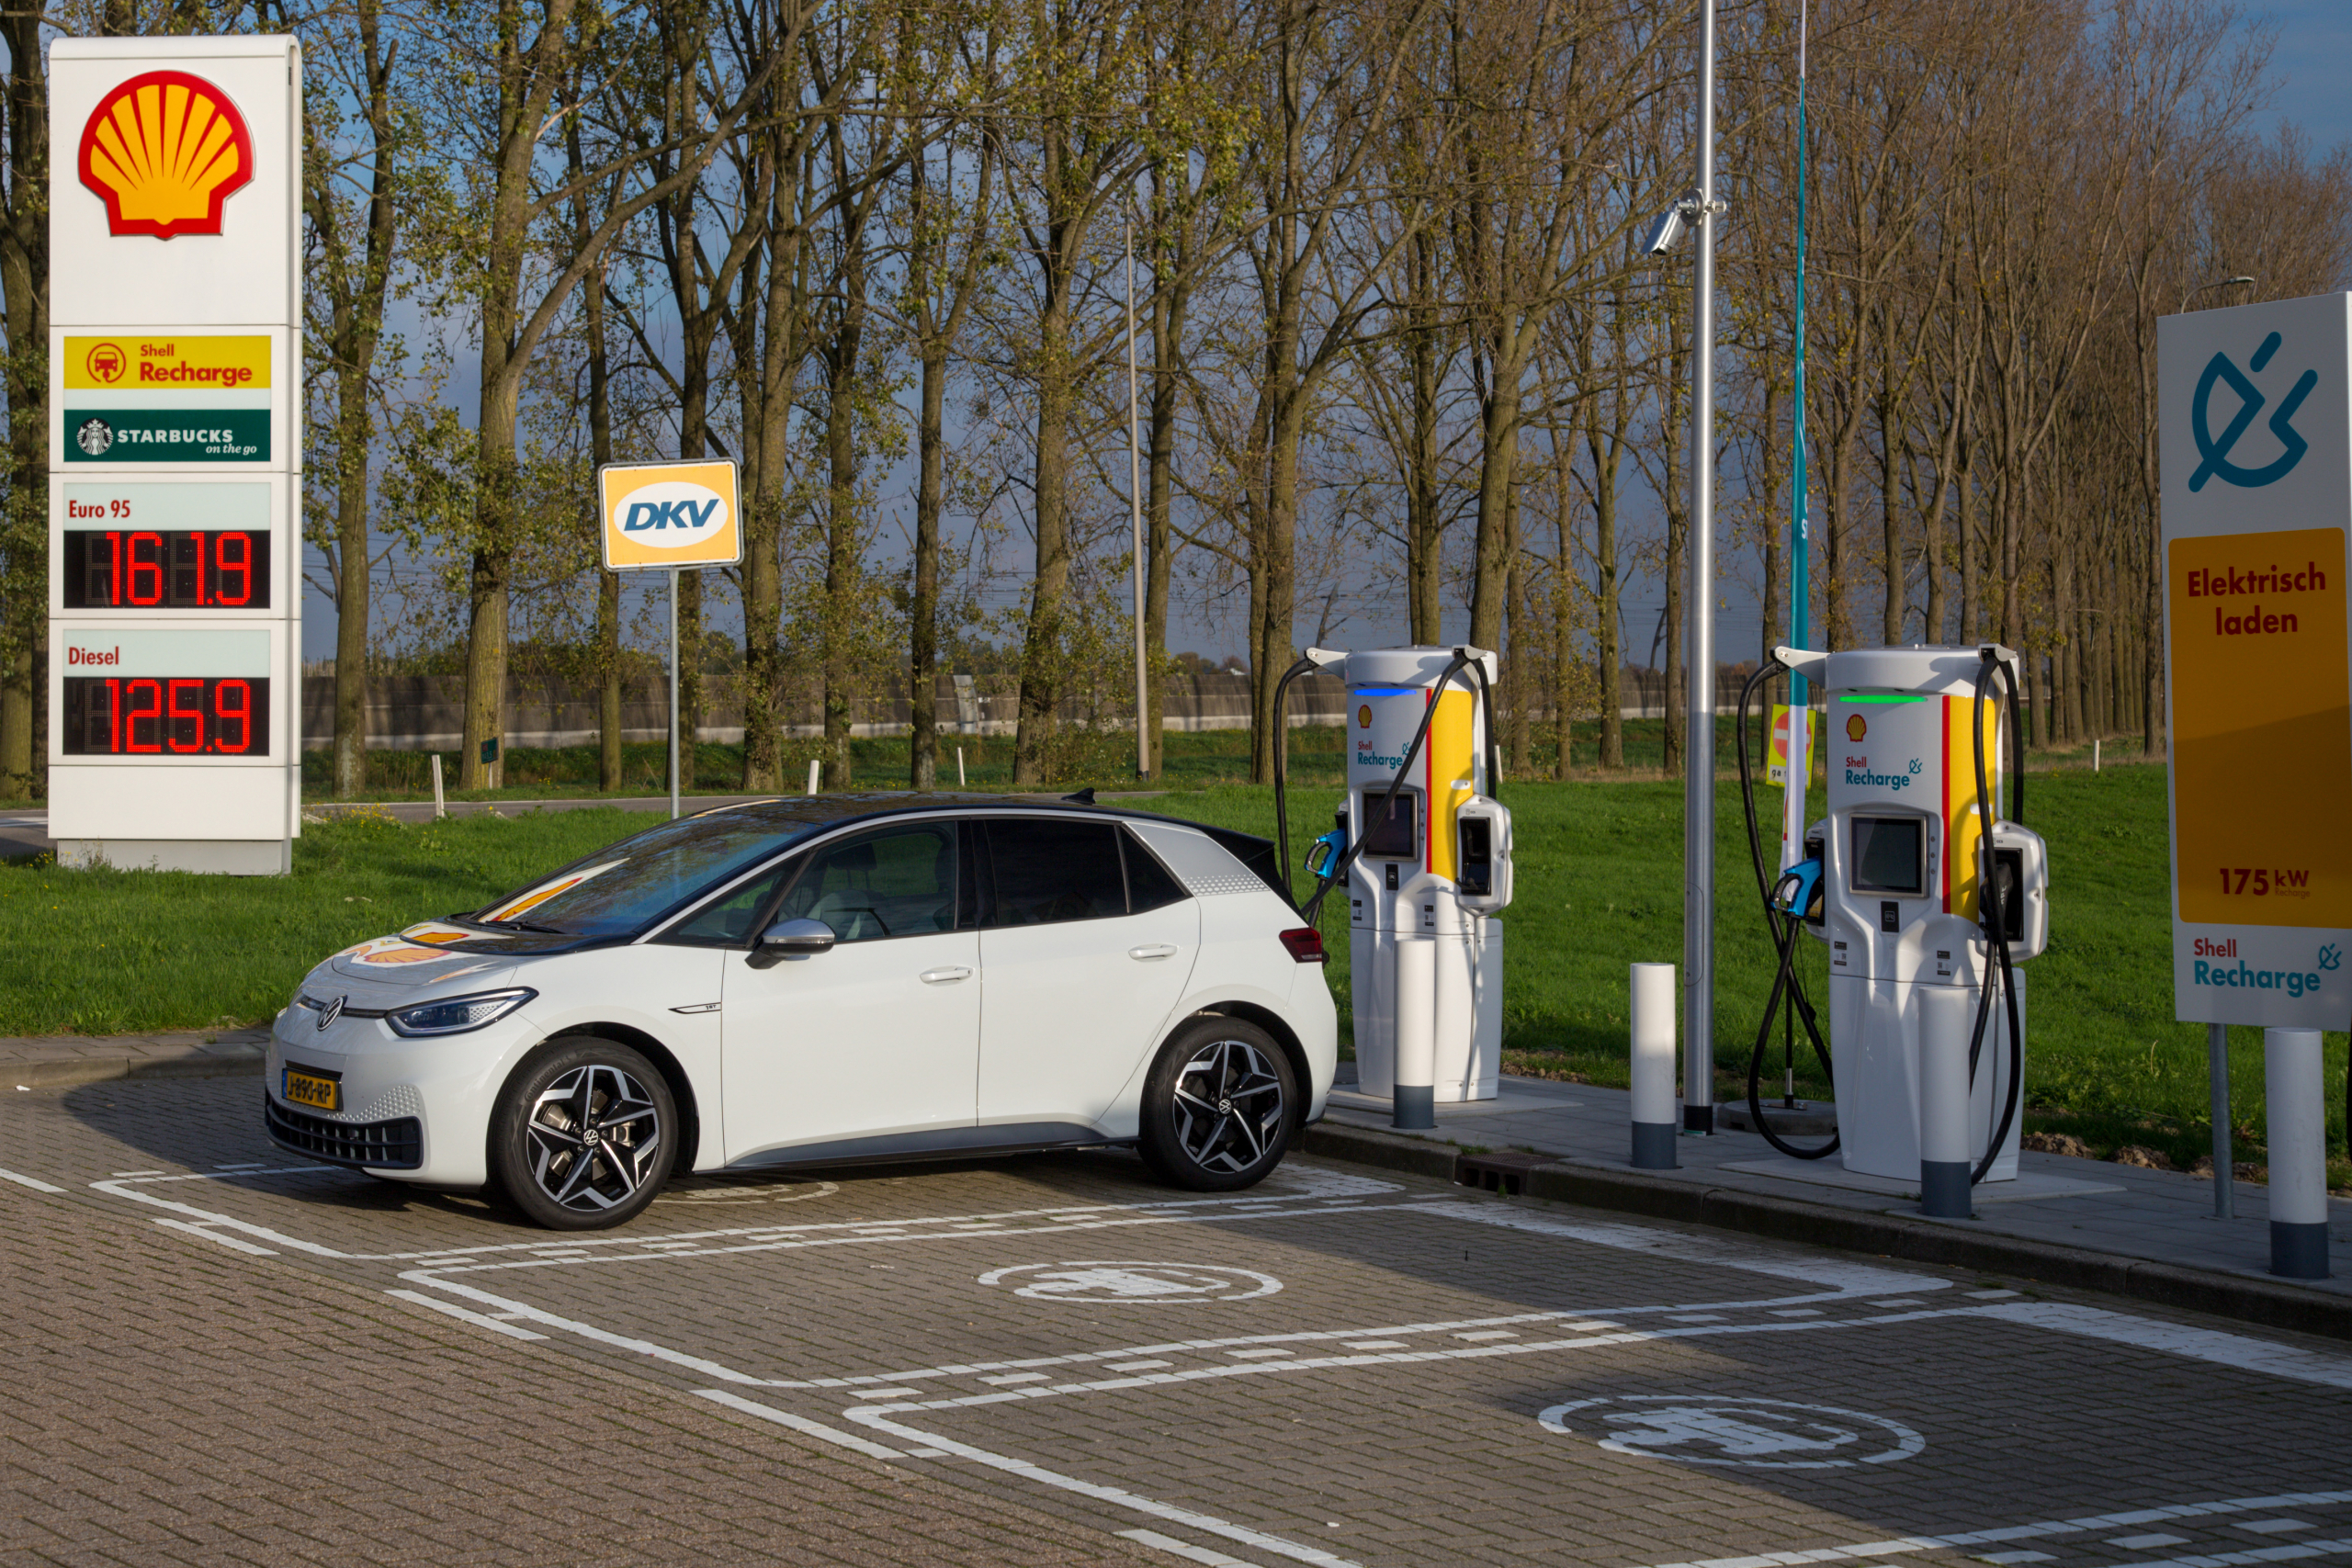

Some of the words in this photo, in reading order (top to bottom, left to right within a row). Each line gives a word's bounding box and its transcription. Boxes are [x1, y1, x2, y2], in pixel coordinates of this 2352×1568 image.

[141, 344, 175, 356] Shell
[140, 361, 253, 387] Recharge
[118, 429, 233, 443] STARBUCKS
[206, 446, 221, 454] on
[222, 443, 242, 454] the
[243, 446, 257, 456] go
[69, 500, 106, 518] Euro
[110, 500, 131, 518] 95
[624, 499, 720, 532] DKV
[106, 532, 252, 605] 161.9
[2188, 561, 2326, 597] Elektrisch
[2216, 604, 2298, 636] laden
[69, 647, 119, 666] Diesel
[106, 679, 250, 752] 125.9
[1358, 740, 1373, 750] Shell
[1358, 751, 1403, 770] Recharge
[1846, 756, 1867, 768] Shell
[1846, 769, 1910, 791] Recharge
[2220, 868, 2269, 897] 175
[2275, 869, 2310, 887] kW
[2275, 887, 2311, 899] Recharge
[2194, 938, 2237, 958] Shell
[2194, 960, 2321, 998] Recharge
[525, 1058, 566, 1102] Continental
